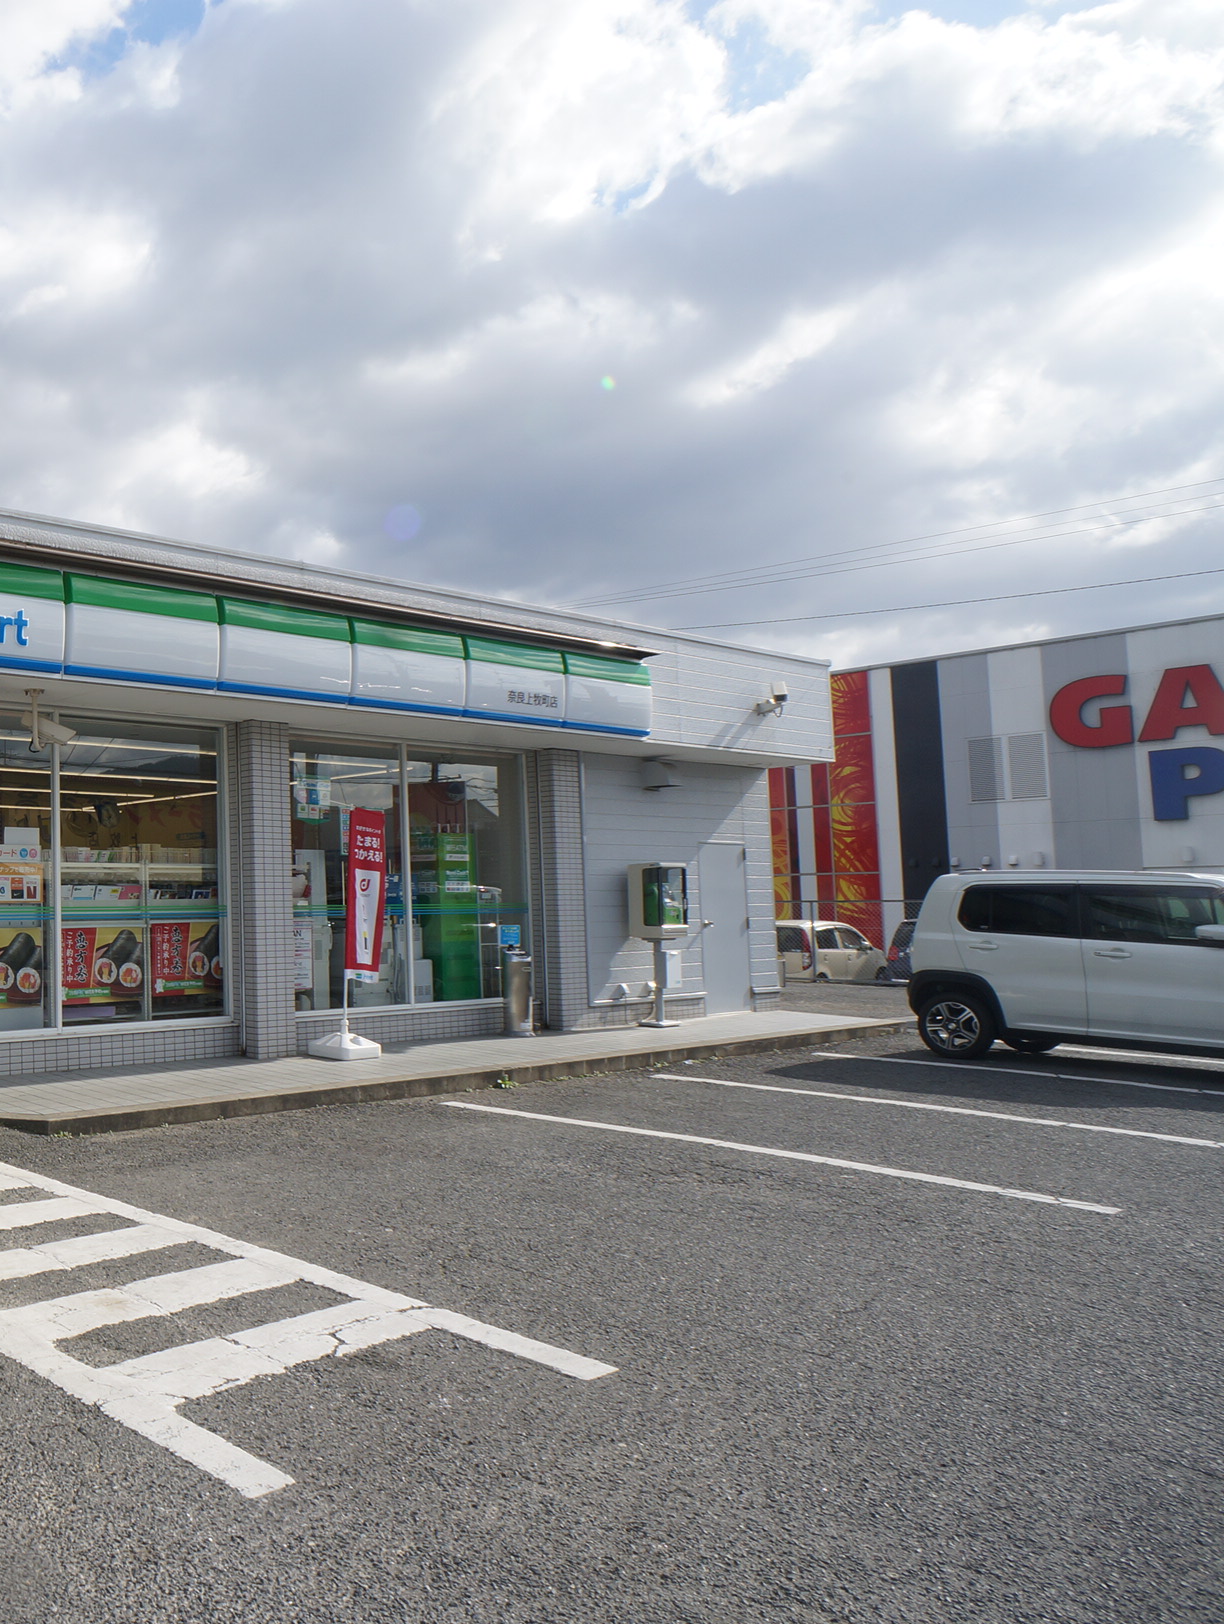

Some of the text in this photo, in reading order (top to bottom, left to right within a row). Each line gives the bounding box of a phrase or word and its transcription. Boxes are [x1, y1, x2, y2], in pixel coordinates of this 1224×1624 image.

[506, 690, 559, 709] 奈良上牧町店
